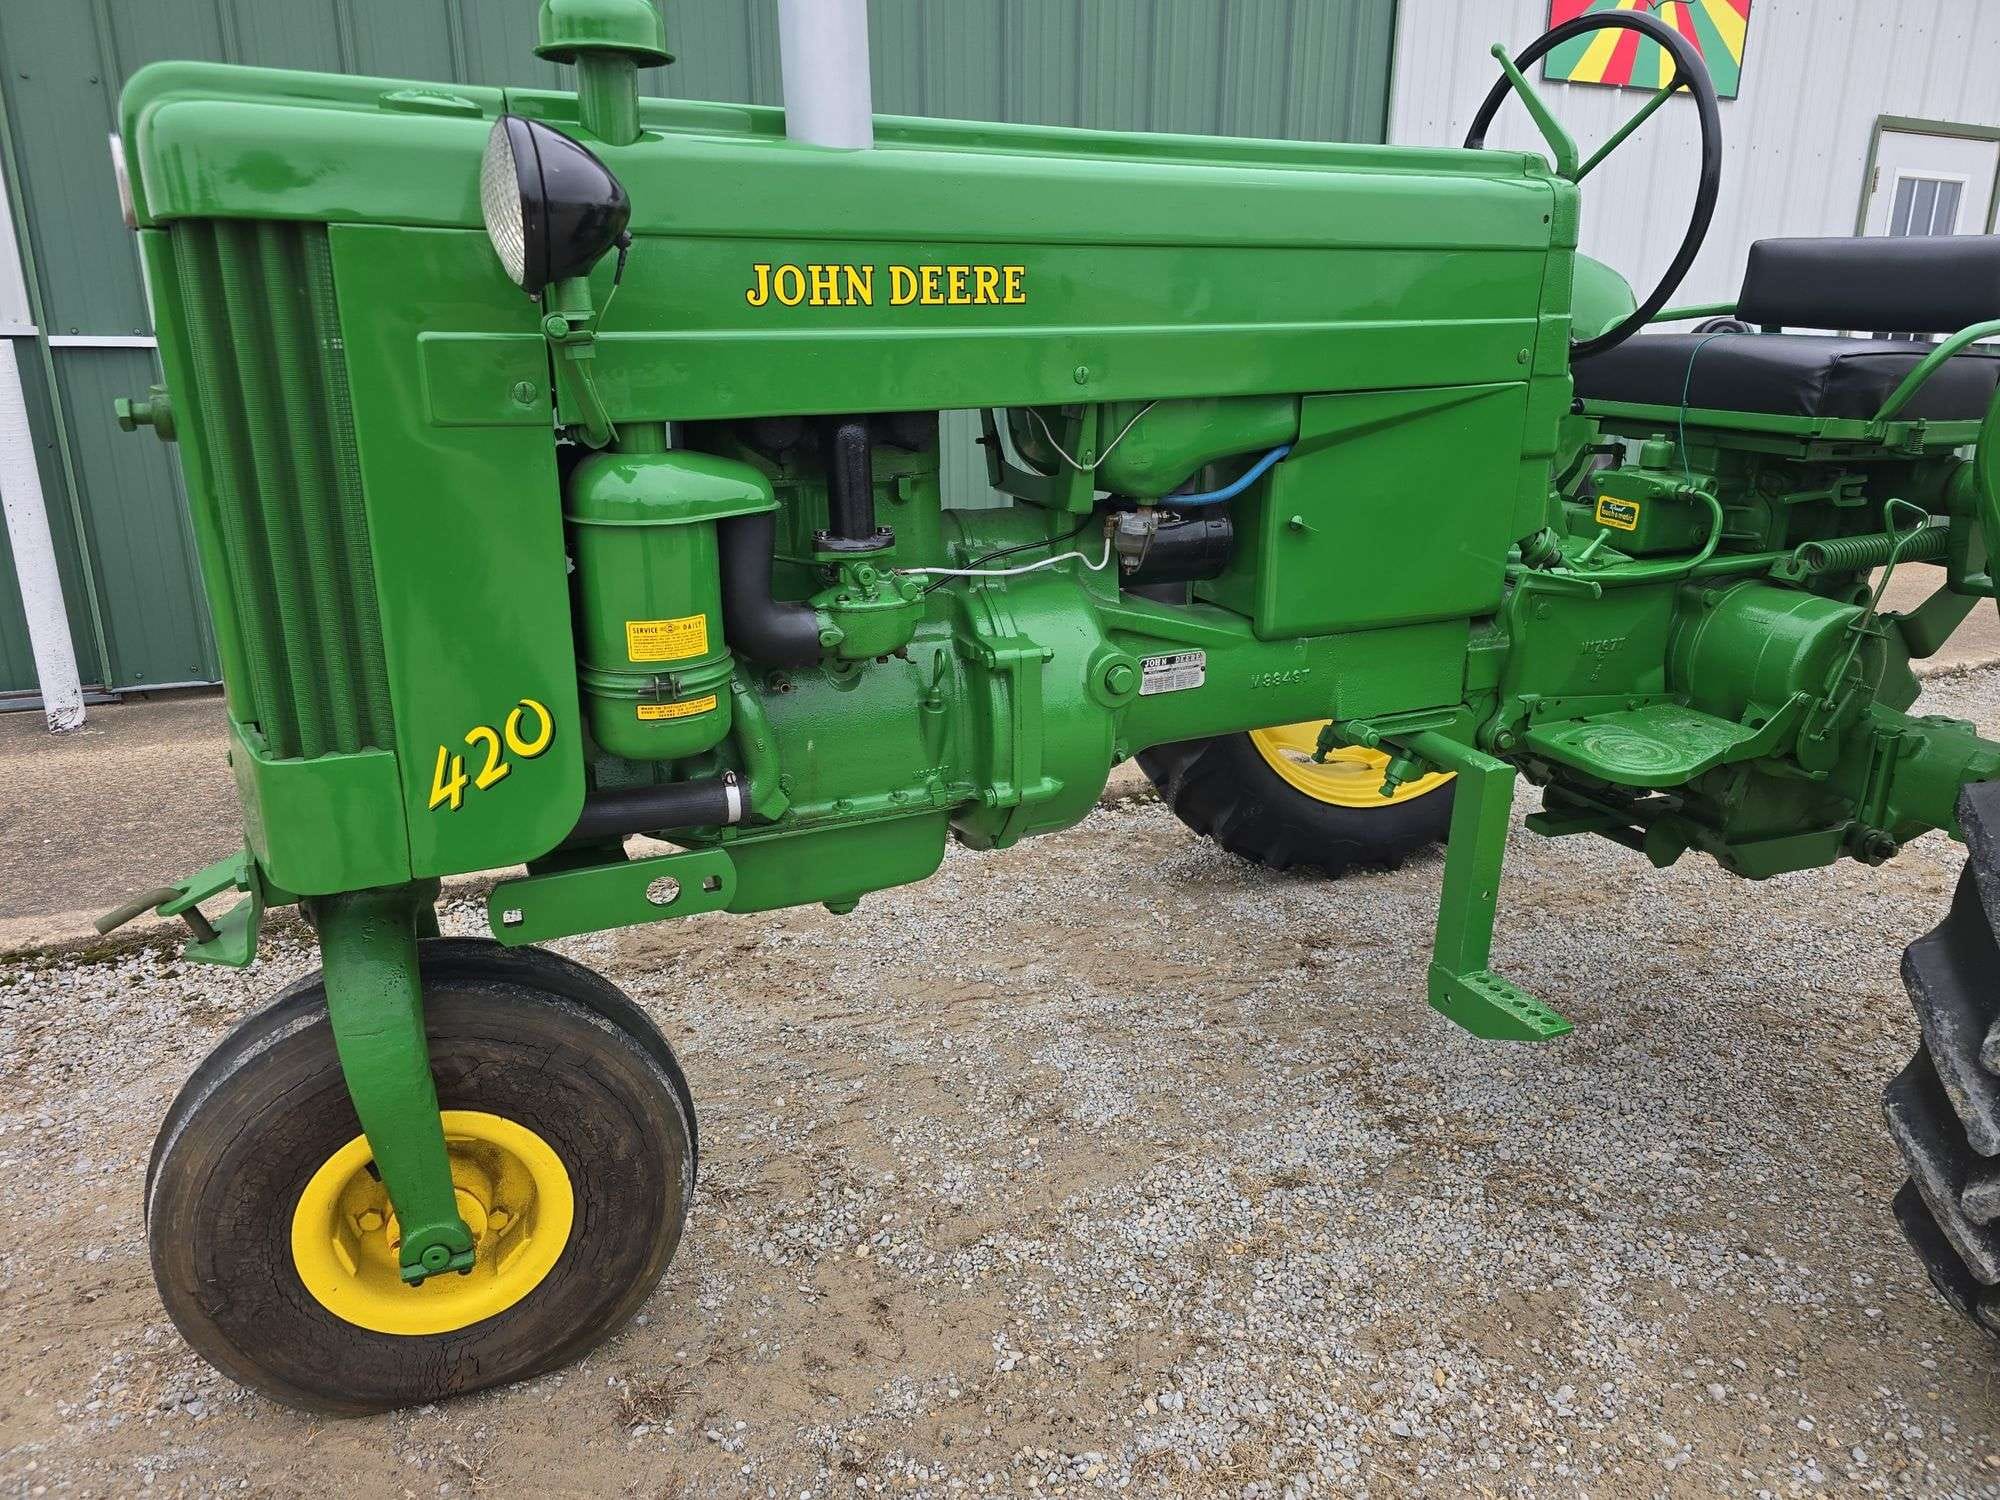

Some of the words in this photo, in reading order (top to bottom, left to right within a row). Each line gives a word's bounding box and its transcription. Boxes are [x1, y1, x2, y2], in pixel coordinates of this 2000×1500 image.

[746, 264, 875, 306] JOHN
[888, 265, 1027, 305] DEERE
[682, 620, 702, 631] DAILY
[1144, 658, 1168, 668] JOHN
[1175, 652, 1201, 663] DEERE
[428, 697, 556, 812] 420
